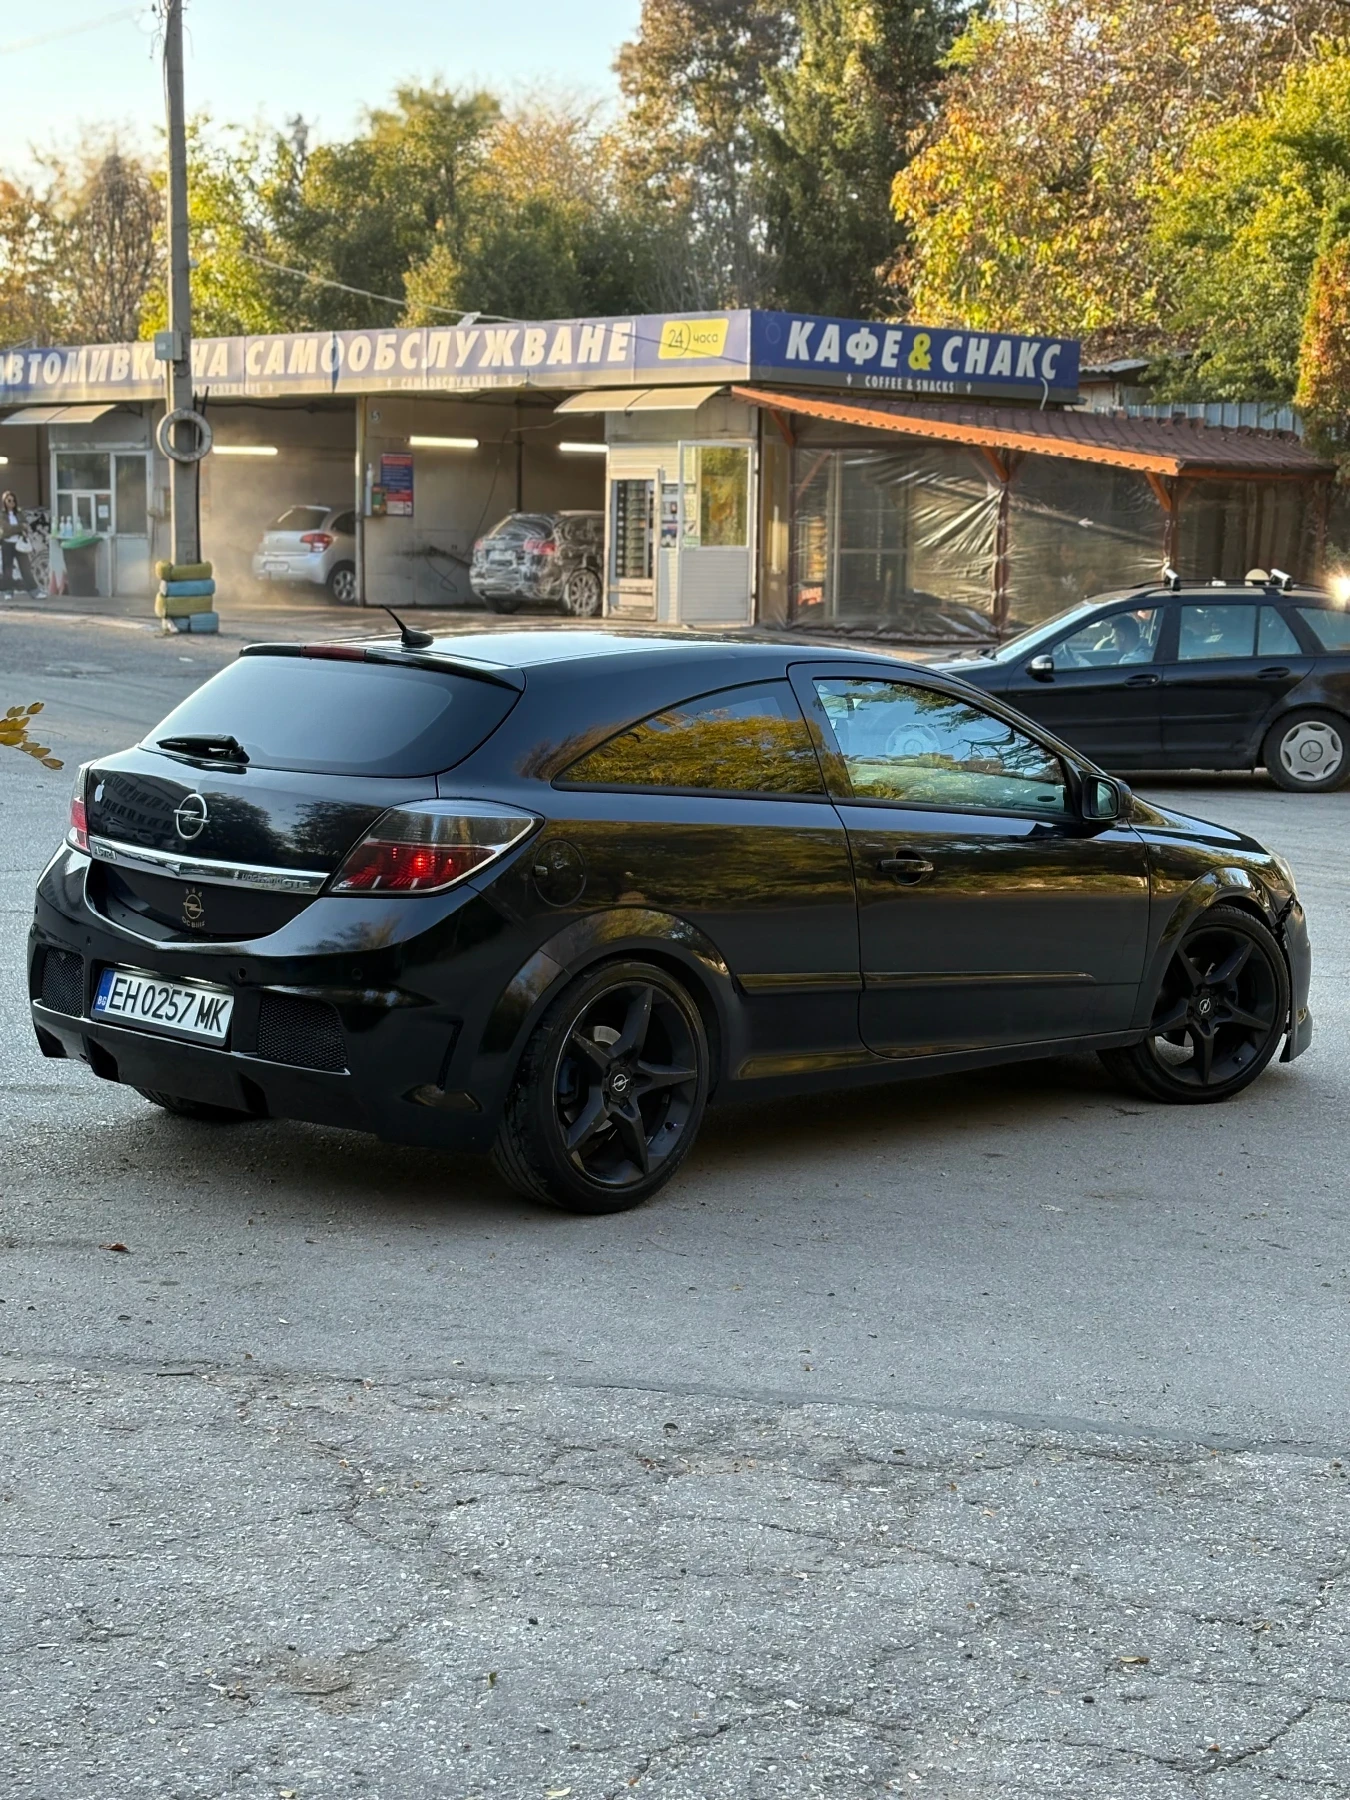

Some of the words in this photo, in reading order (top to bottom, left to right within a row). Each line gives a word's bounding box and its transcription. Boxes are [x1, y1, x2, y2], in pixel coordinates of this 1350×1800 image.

[0, 344, 167, 386] ВТОМИВКА
[191, 343, 228, 378] НА
[245, 322, 632, 376] САМООБСЛУЖВАНЕ
[668, 328, 683, 349] 24
[693, 333, 718, 344] часа
[785, 320, 903, 368] КАФЕ
[908, 332, 932, 371] &
[941, 335, 1061, 380] СНАКС
[865, 375, 902, 390] COFFEE
[907, 378, 913, 391] &
[916, 379, 954, 394] SNACKS
[97, 995, 107, 1007] BG
[108, 977, 142, 1013] EH
[141, 984, 197, 1024] 0257
[194, 995, 229, 1033] MK
